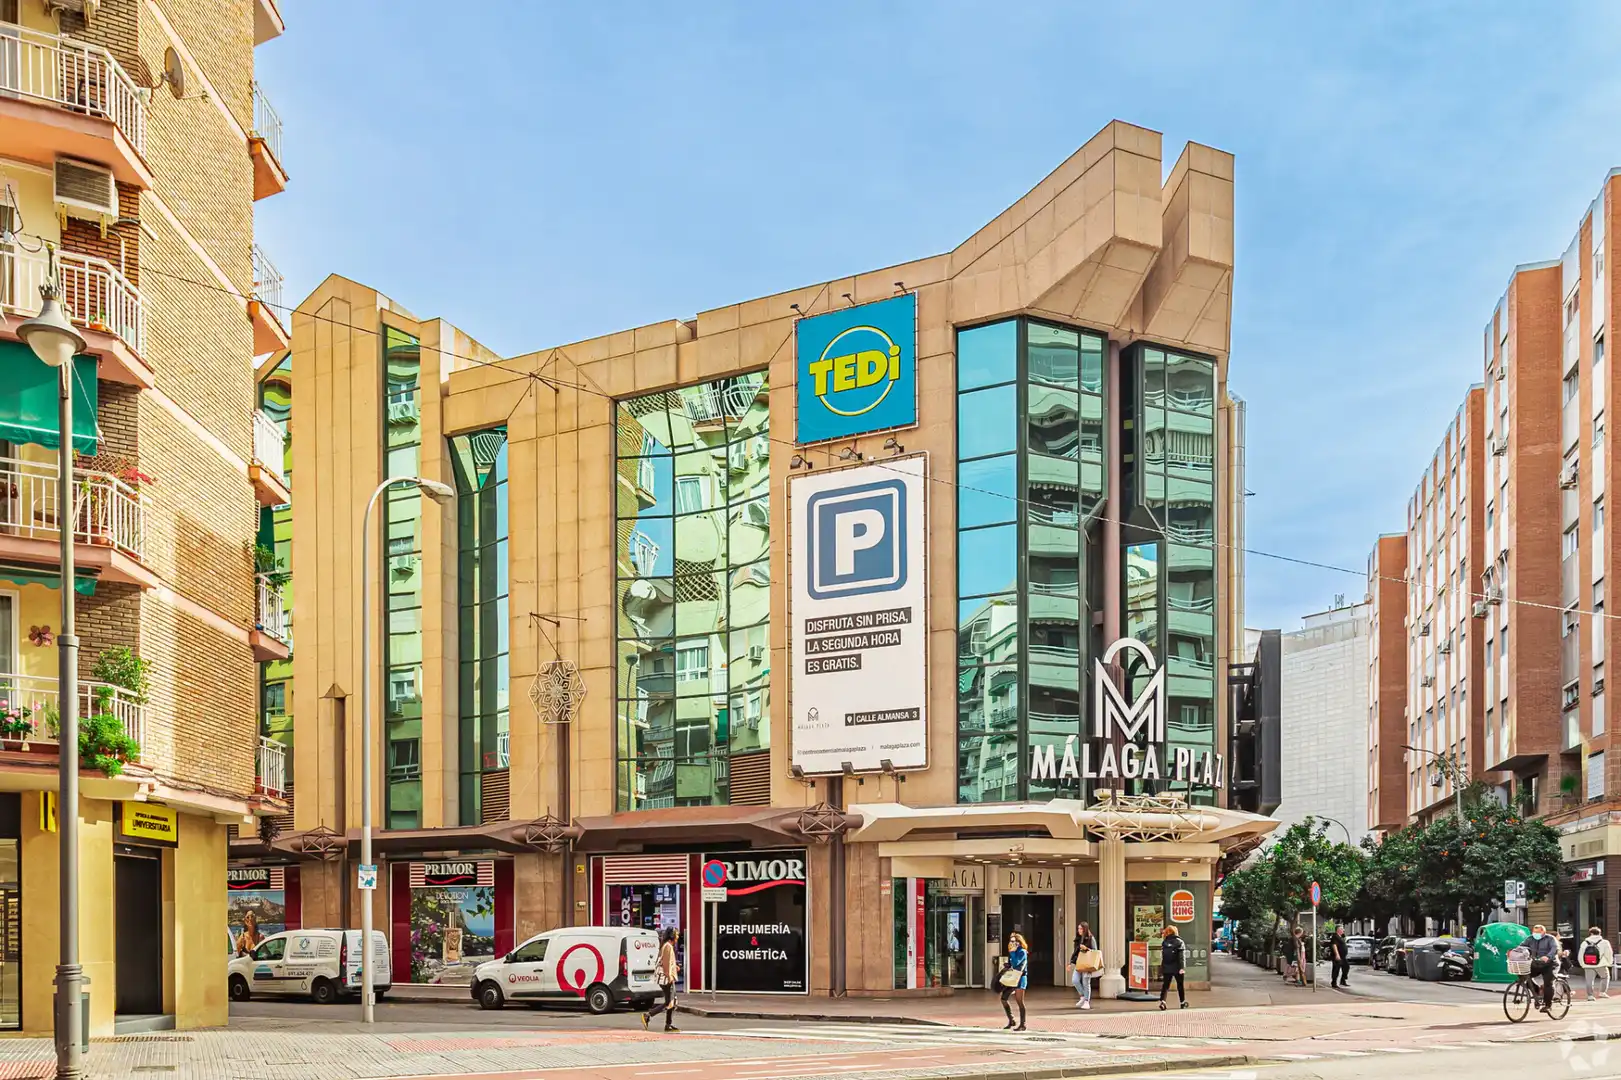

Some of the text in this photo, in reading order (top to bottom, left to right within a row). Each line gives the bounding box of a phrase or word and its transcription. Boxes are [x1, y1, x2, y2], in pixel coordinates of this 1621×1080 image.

[809, 344, 901, 397] TEDi
[835, 508, 885, 576] P
[807, 610, 909, 632] DISFRUTA SIN PRISA,
[807, 632, 900, 653] LA SEGUNDA HORA
[807, 656, 859, 673] ES GRATIS.
[856, 715, 876, 723] CALLE
[878, 712, 909, 722] ALMANSA
[1031, 735, 1225, 789] MÁLAGA PLAZ
[228, 869, 268, 880] PRIMOR
[424, 863, 475, 876] PRIMOR
[722, 859, 805, 881] RIMOR
[1009, 871, 1053, 889] PLAZA
[1172, 907, 1194, 916] KING
[719, 922, 791, 934] PERFUMERÍA
[751, 936, 759, 946] &
